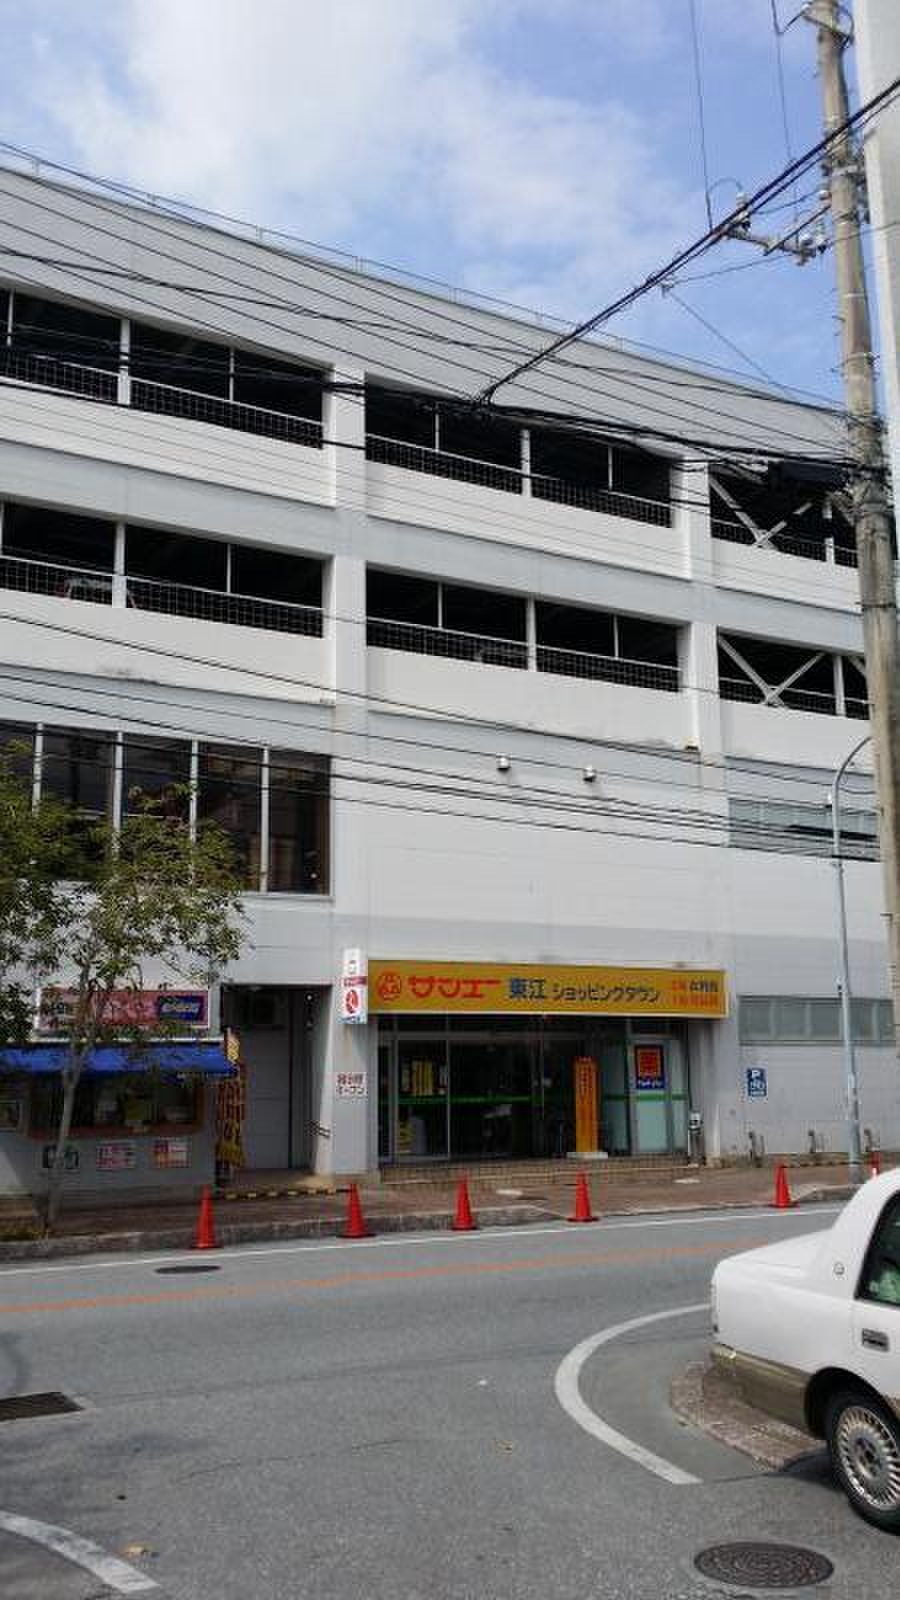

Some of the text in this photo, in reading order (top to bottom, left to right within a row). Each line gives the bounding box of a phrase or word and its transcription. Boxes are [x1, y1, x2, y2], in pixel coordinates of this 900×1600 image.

[509, 976, 548, 999] 東江
[552, 984, 662, 1003] ショッピングタウン
